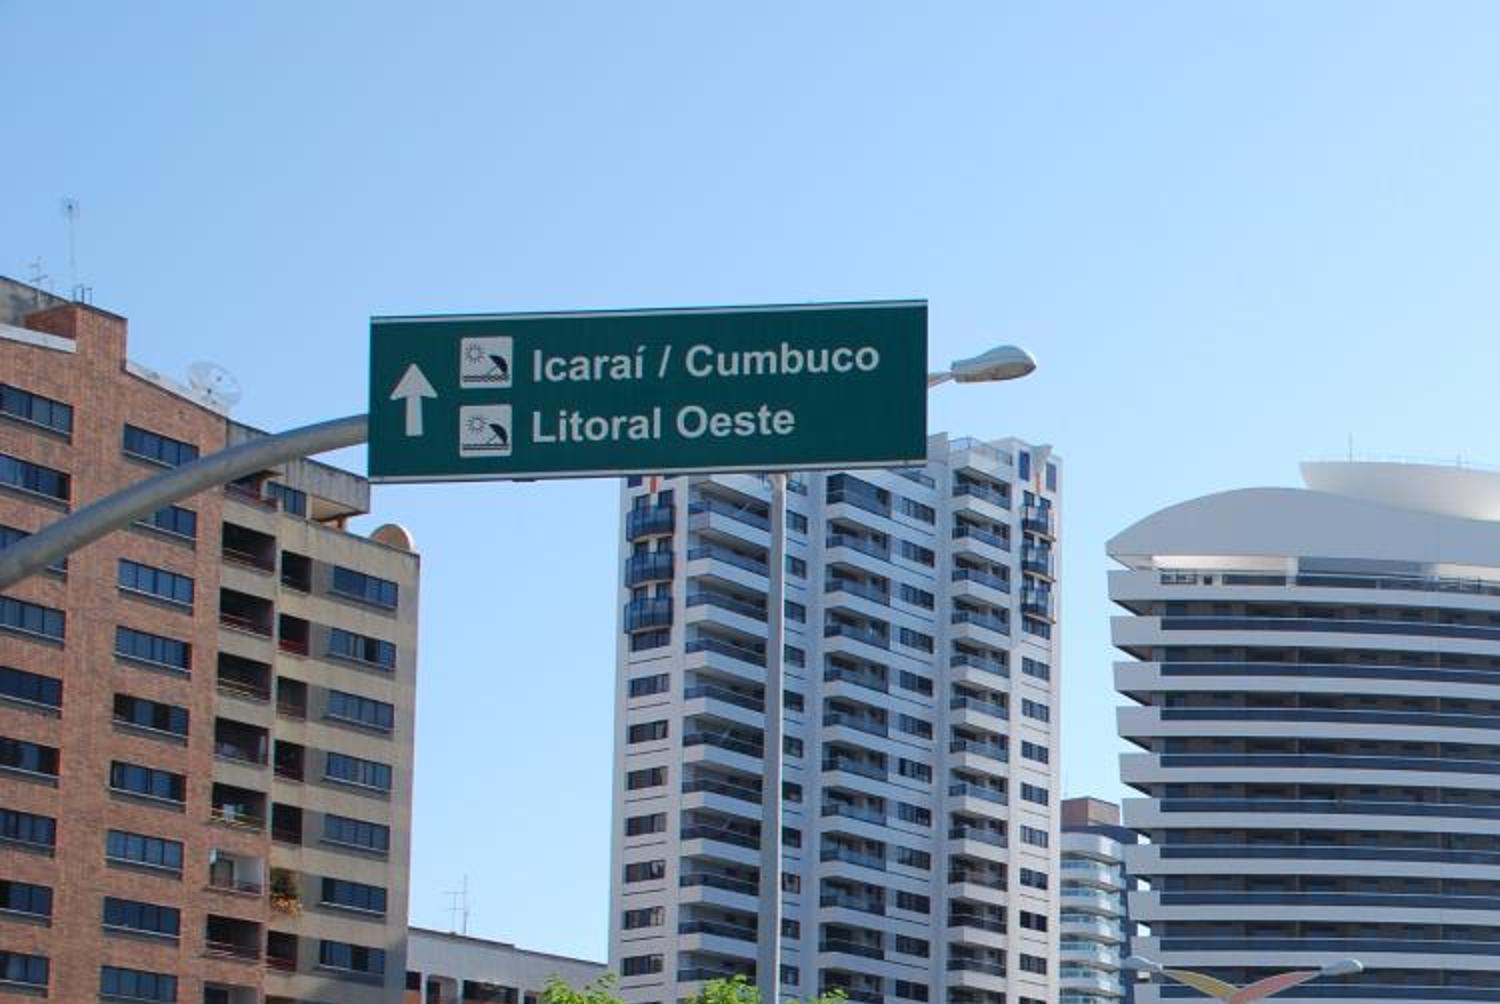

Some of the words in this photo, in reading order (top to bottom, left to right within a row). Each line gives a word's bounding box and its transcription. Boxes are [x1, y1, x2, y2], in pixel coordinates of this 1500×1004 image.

[532, 345, 646, 382] Icaraí
[657, 345, 672, 379] /
[685, 342, 880, 378] Cumbuco
[532, 406, 661, 443] Litoral
[676, 404, 796, 438] Oeste
